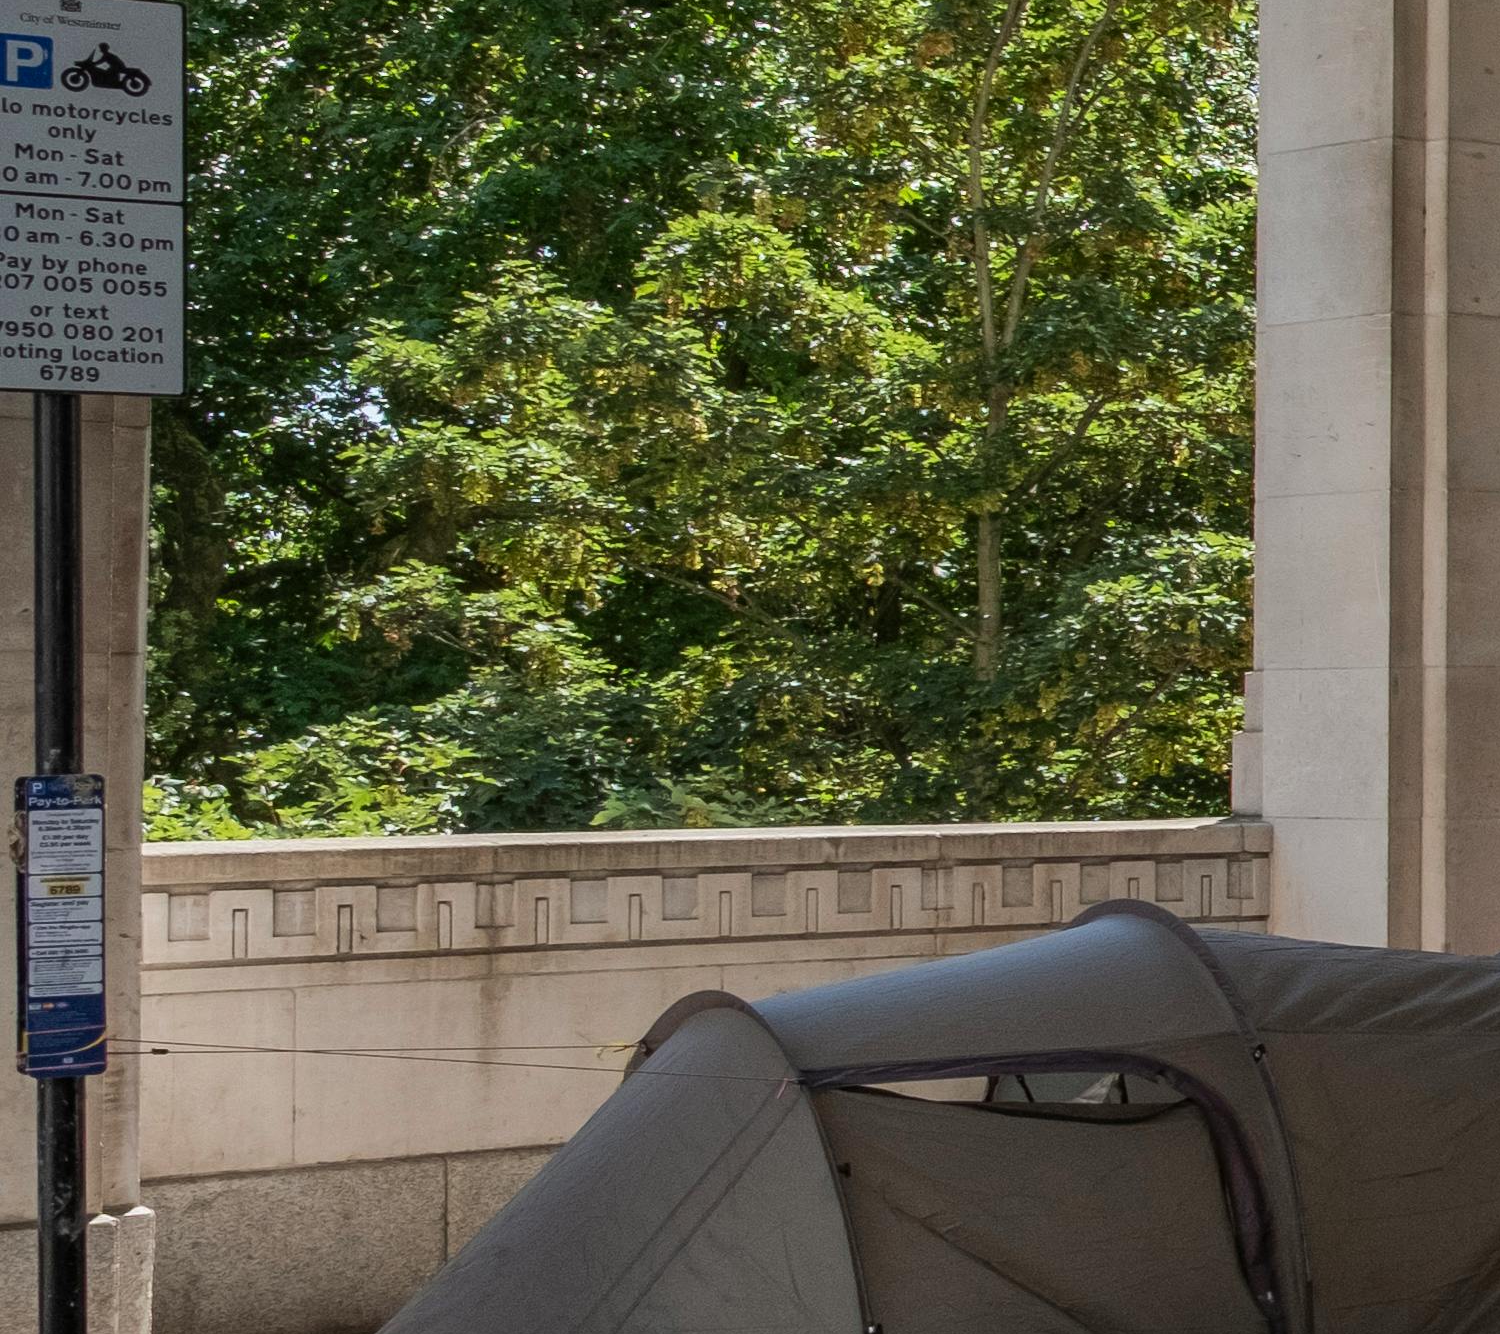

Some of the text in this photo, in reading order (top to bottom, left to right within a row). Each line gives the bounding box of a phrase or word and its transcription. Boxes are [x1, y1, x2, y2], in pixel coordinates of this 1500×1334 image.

[6, 39, 44, 82] P
[32, 103, 173, 126] motorcycles
[48, 124, 97, 144] only
[14, 143, 64, 162] Mon
[84, 148, 124, 167] Sat
[24, 171, 58, 186] am
[78, 171, 132, 190] 7.00
[138, 178, 172, 194] pm
[15, 202, 66, 221] Mon
[84, 207, 126, 225] Sat
[26, 230, 60, 245] am
[80, 230, 135, 249] 6.30
[140, 238, 174, 252] pm
[42, 254, 70, 274] by
[78, 257, 148, 276] phone
[0, 273, 168, 297] 07 005 0055
[30, 303, 110, 321] or text
[64, 324, 114, 342] 080
[122, 326, 164, 344] 201
[0, 343, 164, 364] oting location
[40, 364, 100, 382] 6789
[32, 782, 43, 794] P
[28, 796, 102, 808] Pay-to-Park
[49, 884, 81, 896] 6789
